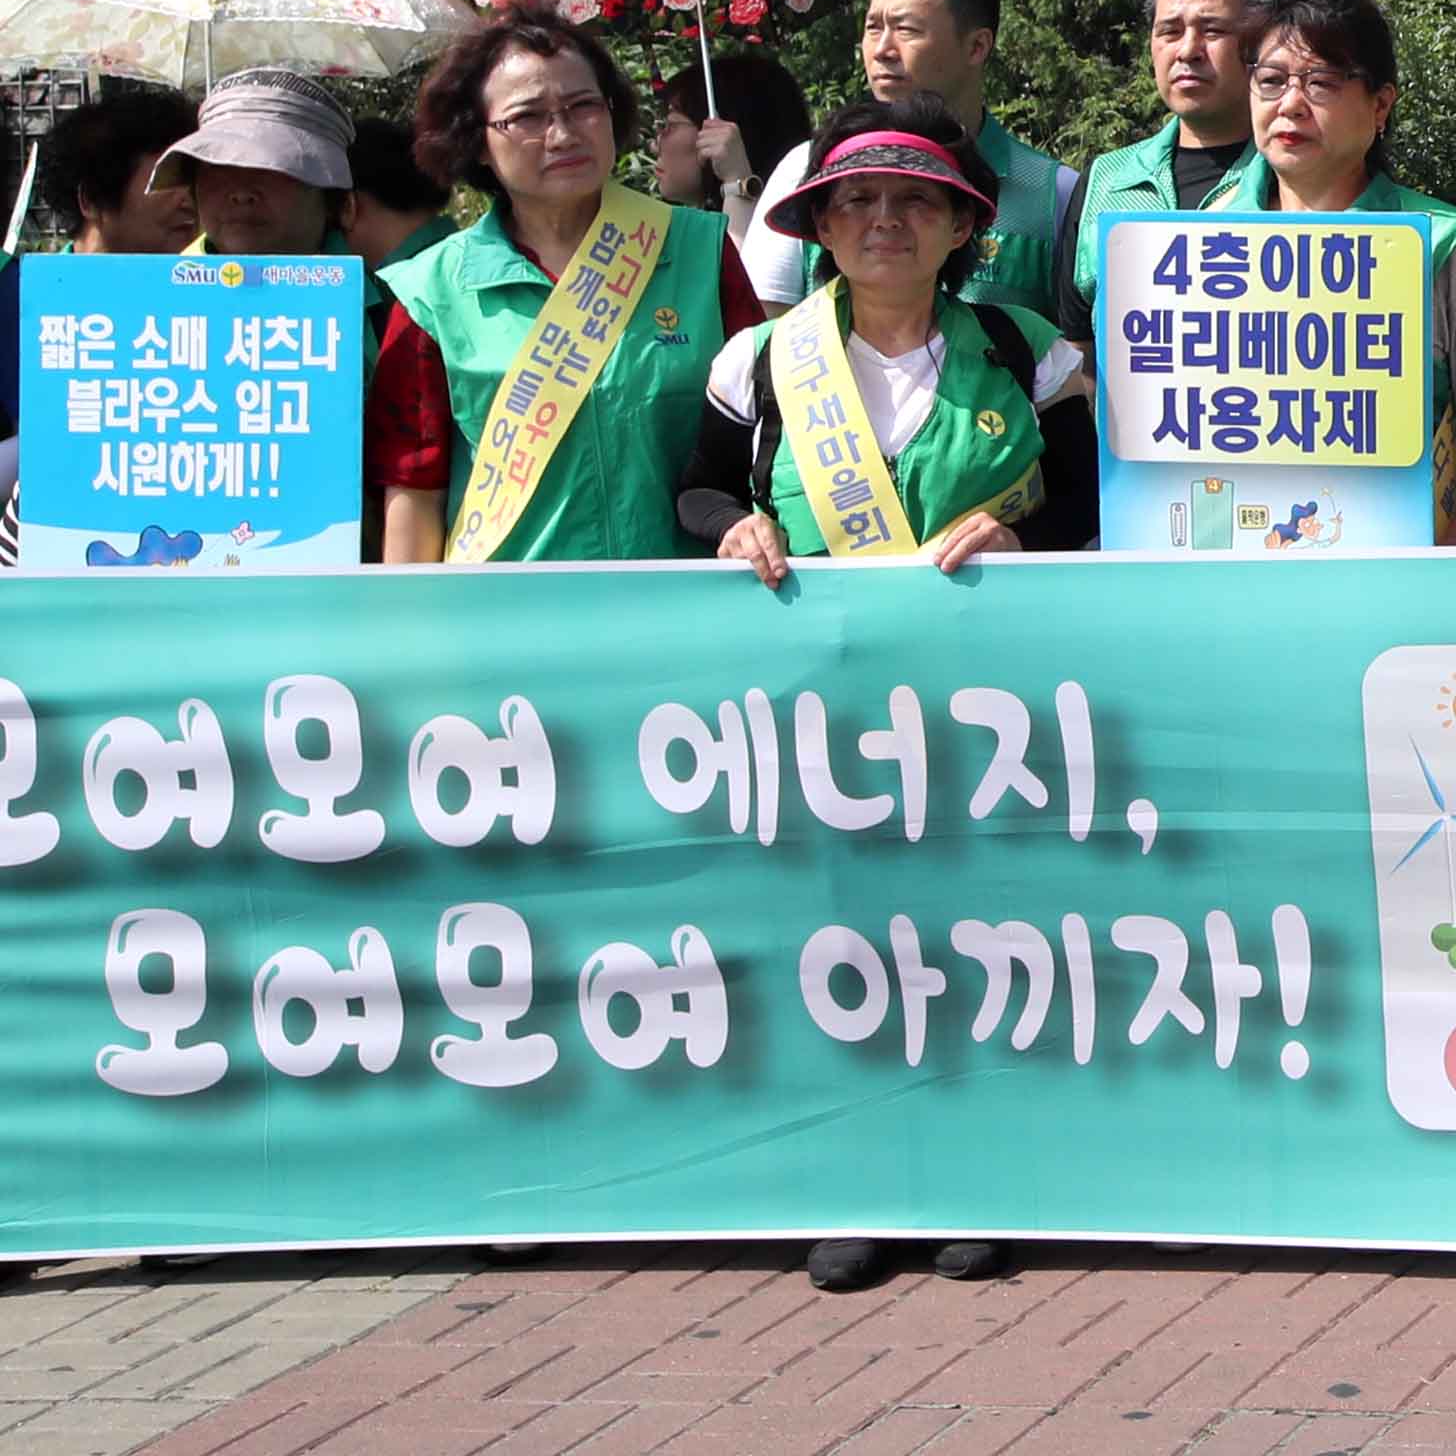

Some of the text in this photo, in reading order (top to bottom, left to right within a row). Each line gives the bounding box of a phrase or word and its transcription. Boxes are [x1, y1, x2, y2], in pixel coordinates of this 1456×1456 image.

[173, 262, 217, 285] SMU
[262, 264, 345, 286] 새마을운동
[1153, 231, 1377, 300] 4층이하
[39, 314, 341, 372] 짧은 소매 셔츠나
[653, 331, 690, 346] SMU
[1122, 309, 1404, 377] 엘리베이터
[66, 380, 310, 434] 블라우스 입고
[1152, 386, 1378, 454] 사용자제
[92, 441, 280, 498] 시원하게!!
[805, 393, 892, 552] 새마을회
[639, 680, 1158, 855] 에너지,
[96, 902, 1311, 1096] 모여모여 아끼자!
